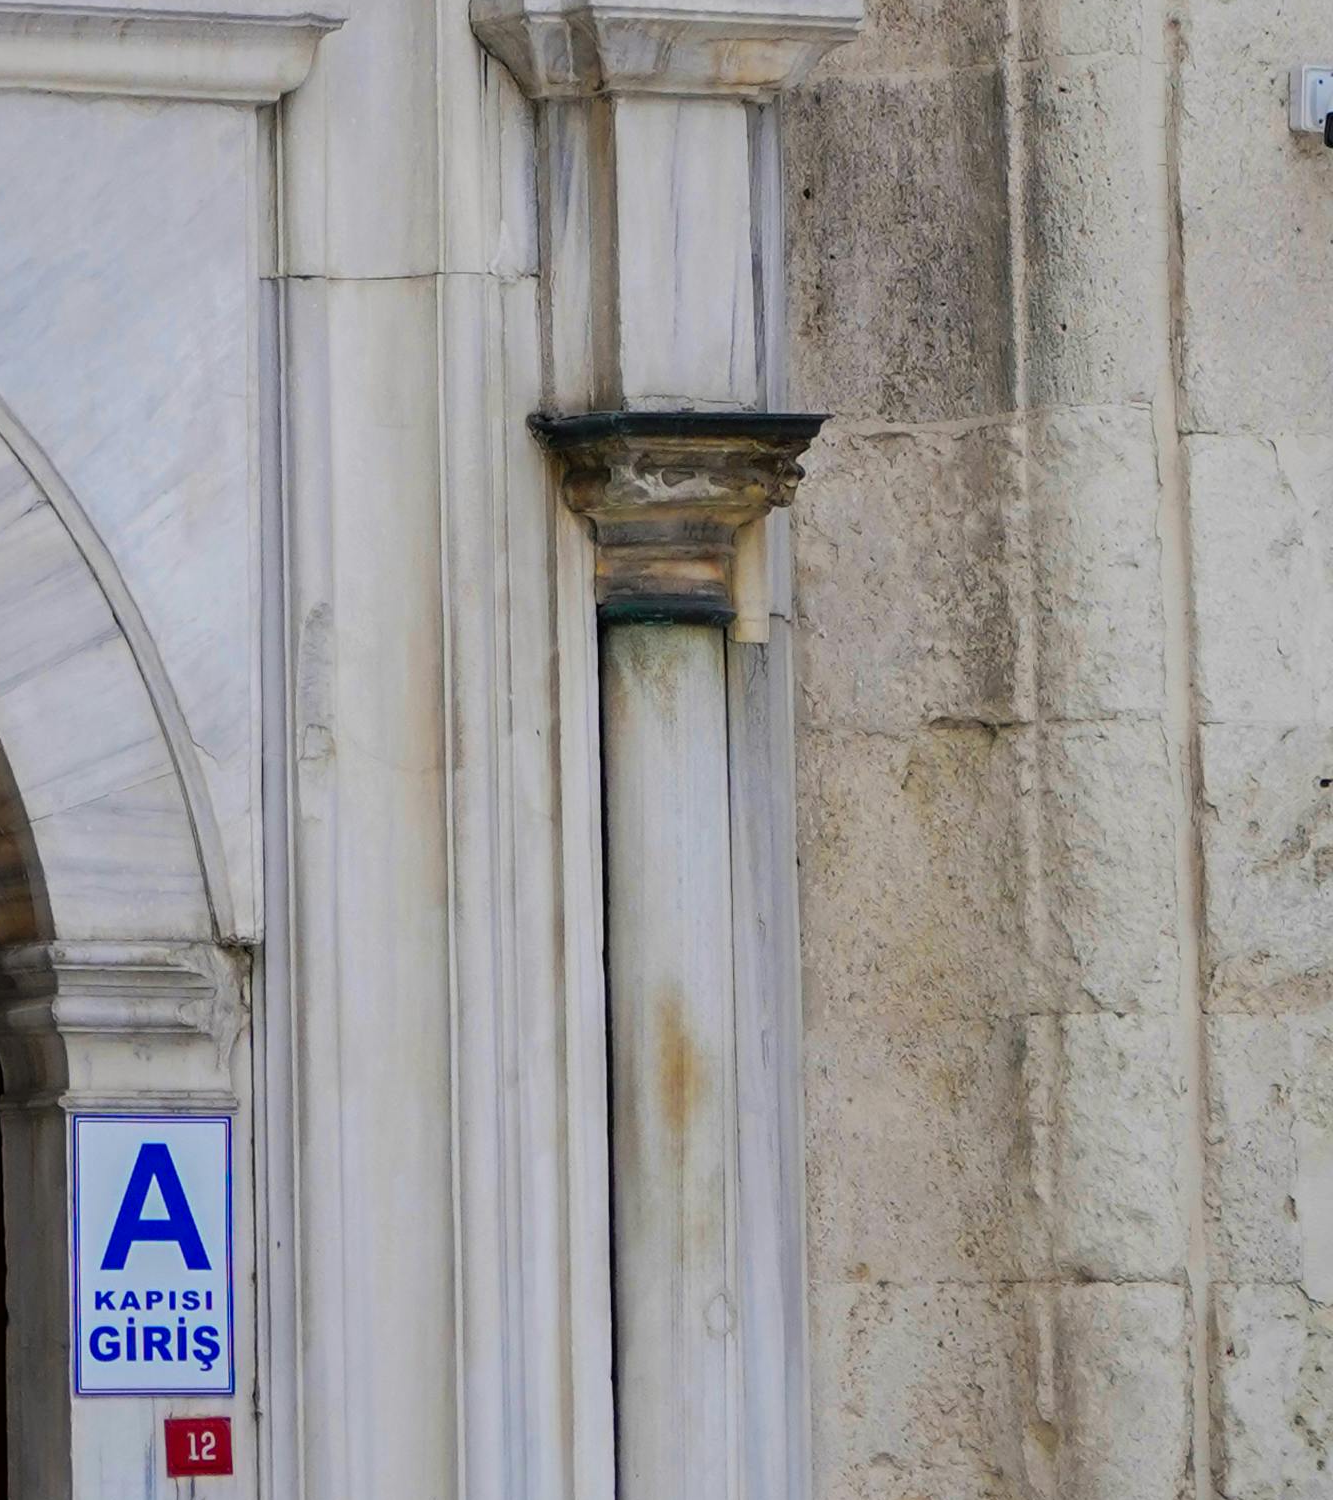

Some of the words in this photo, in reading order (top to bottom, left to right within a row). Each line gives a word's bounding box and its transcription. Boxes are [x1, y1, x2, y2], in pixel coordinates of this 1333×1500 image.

[99, 1142, 211, 1272] A
[93, 1290, 216, 1312] KAPISI
[88, 1317, 223, 1372] GİRİŞ
[187, 1431, 218, 1462] 12
